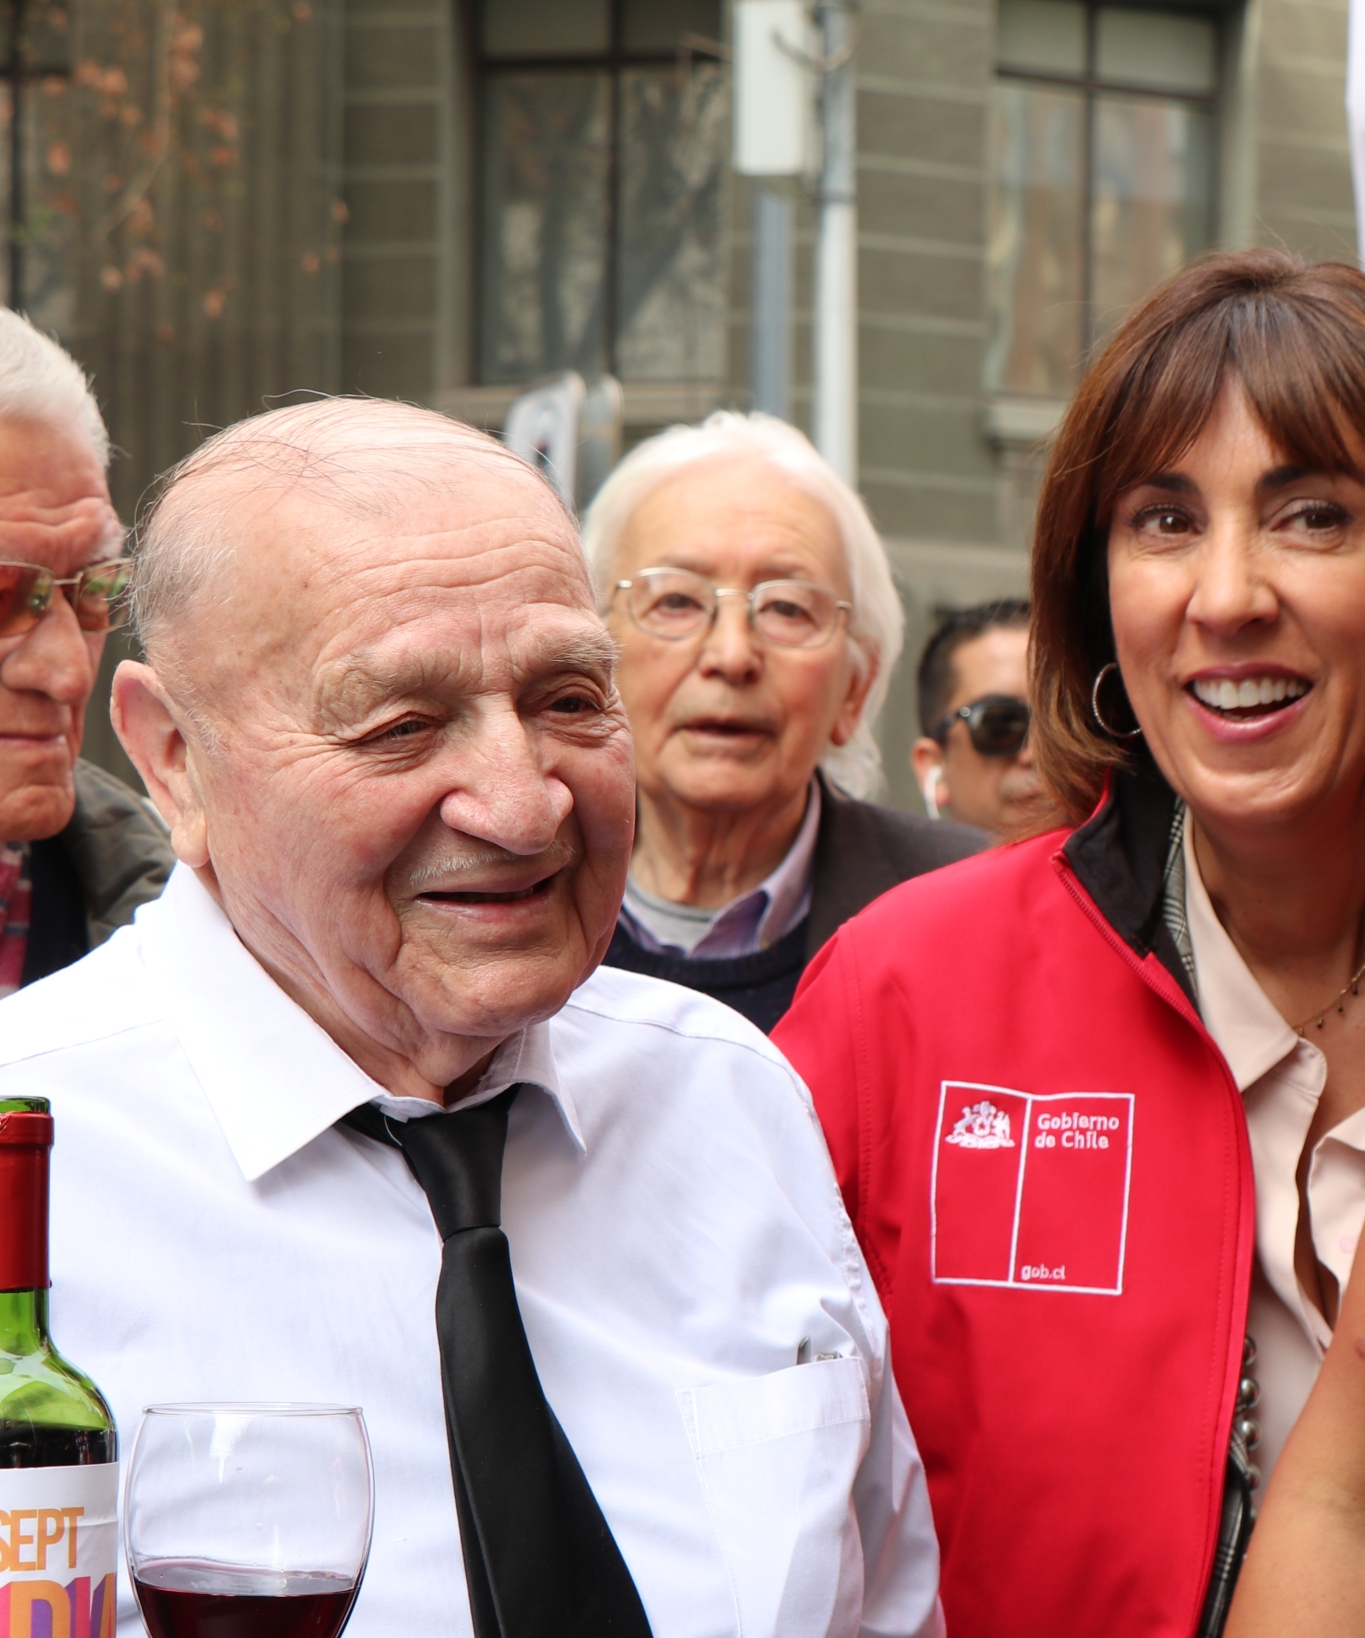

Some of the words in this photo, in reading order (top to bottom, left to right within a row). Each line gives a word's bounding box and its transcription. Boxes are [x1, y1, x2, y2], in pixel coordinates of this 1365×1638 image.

[1037, 1112, 1120, 1131] Gobierno
[1034, 1131, 1056, 1149] de
[1061, 1131, 1110, 1150] Chile
[1020, 1263, 1066, 1281] gob.cl
